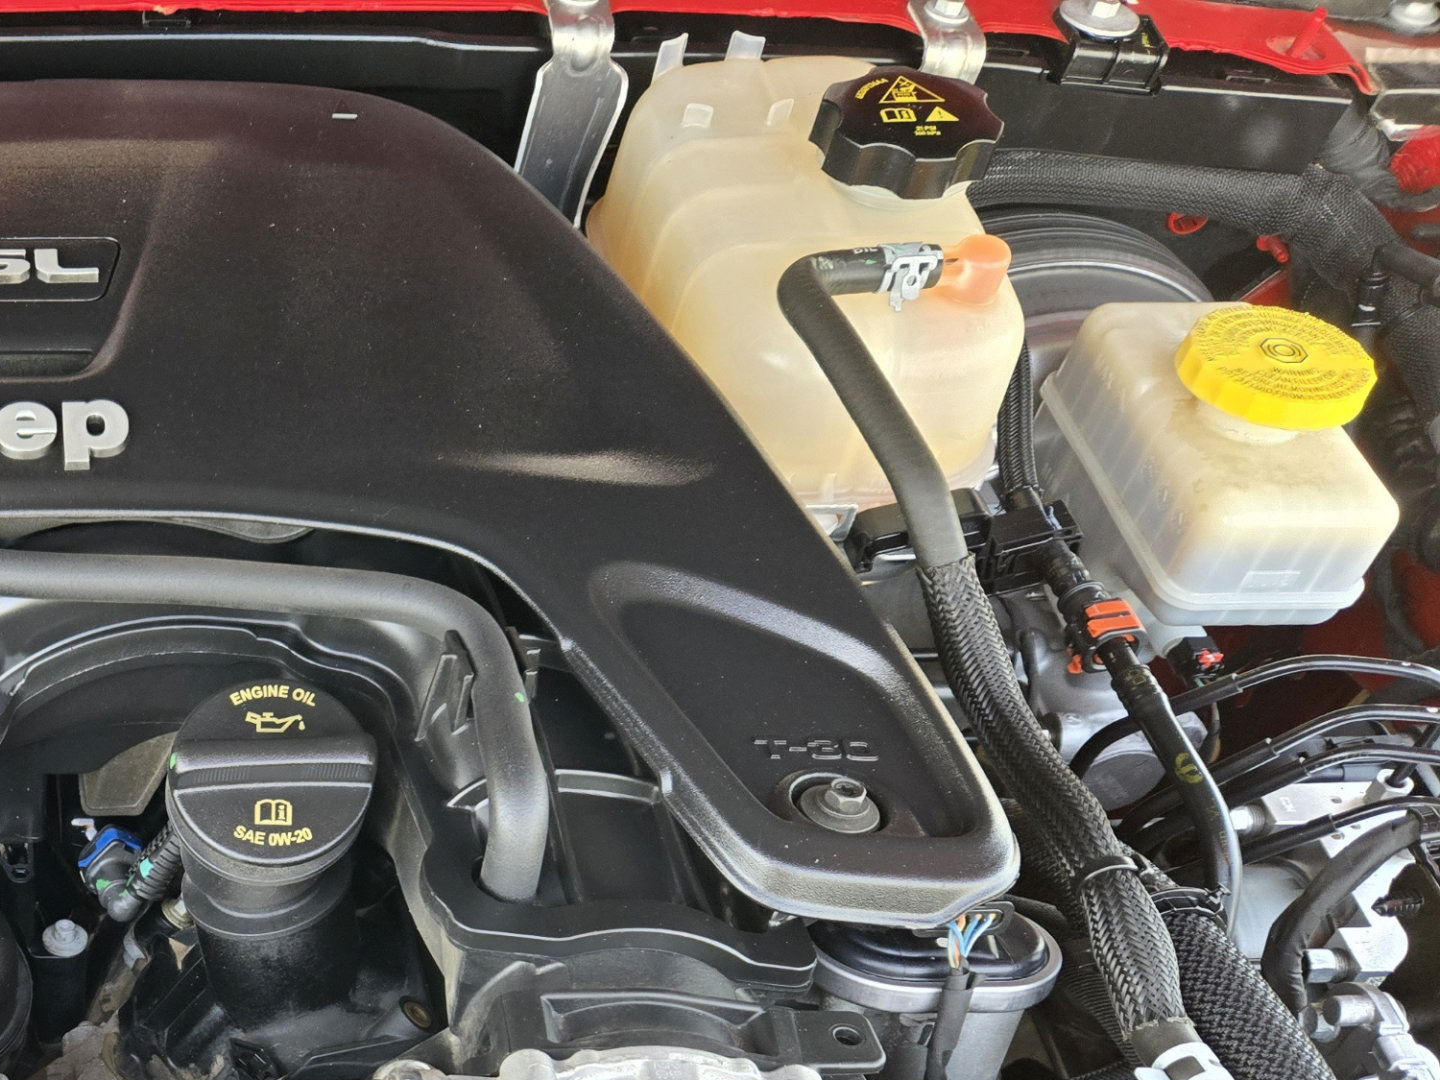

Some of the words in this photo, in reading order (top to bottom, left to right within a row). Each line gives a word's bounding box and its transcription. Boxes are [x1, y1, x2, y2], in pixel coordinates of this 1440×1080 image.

[229, 684, 290, 707] ENGINE
[292, 688, 316, 707] OIL
[233, 825, 266, 846] SAE
[268, 827, 313, 847] 0W-20
